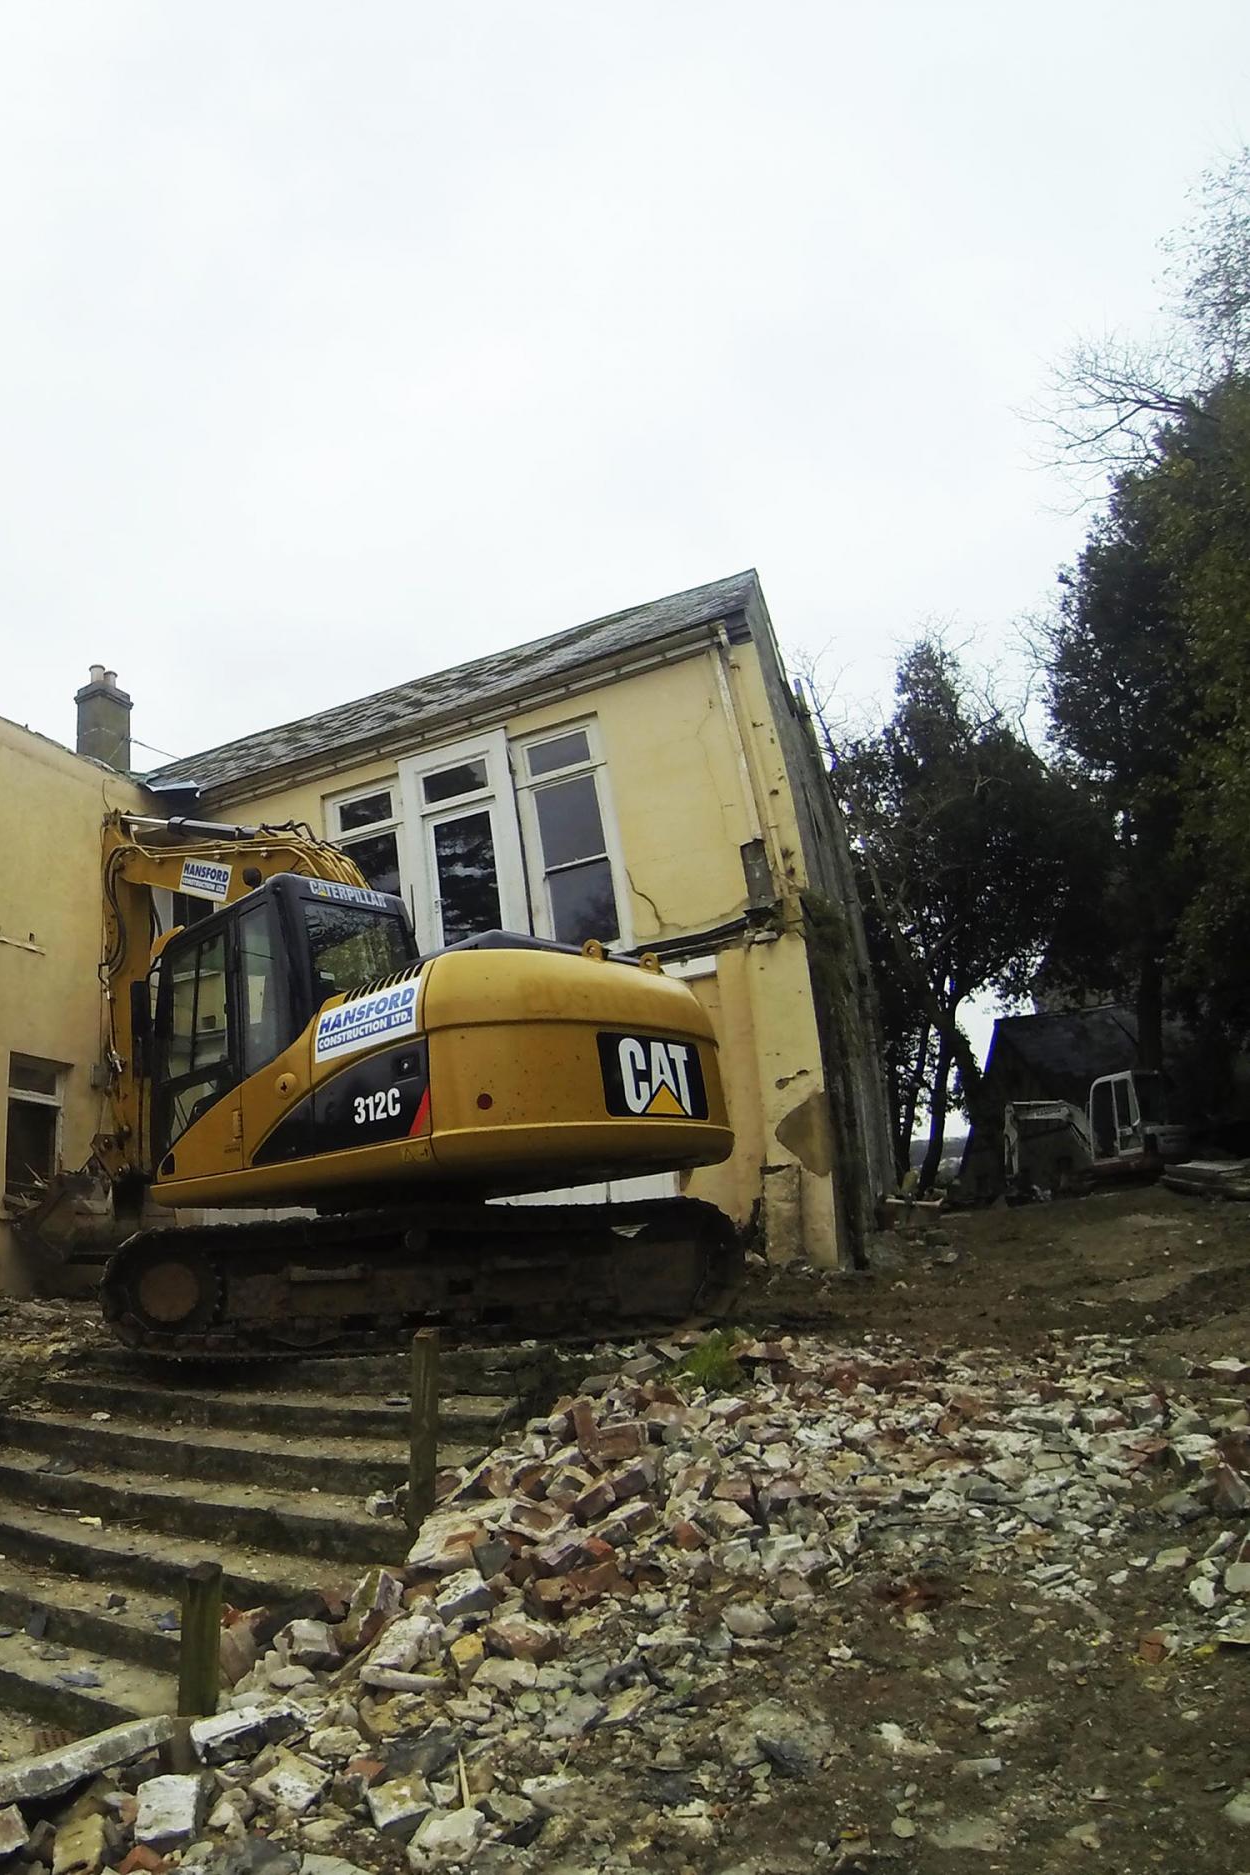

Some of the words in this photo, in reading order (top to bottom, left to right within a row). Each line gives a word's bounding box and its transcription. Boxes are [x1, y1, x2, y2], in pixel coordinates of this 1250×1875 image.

[183, 862, 229, 883] HANSFORD
[309, 880, 387, 908] CATERPILLAR
[317, 1016, 388, 1051] CONSTRUCTION
[390, 1009, 412, 1027] LTD.
[318, 987, 415, 1036] HANSFORD
[618, 1037, 693, 1117] CAT
[353, 1086, 402, 1125] 312C
